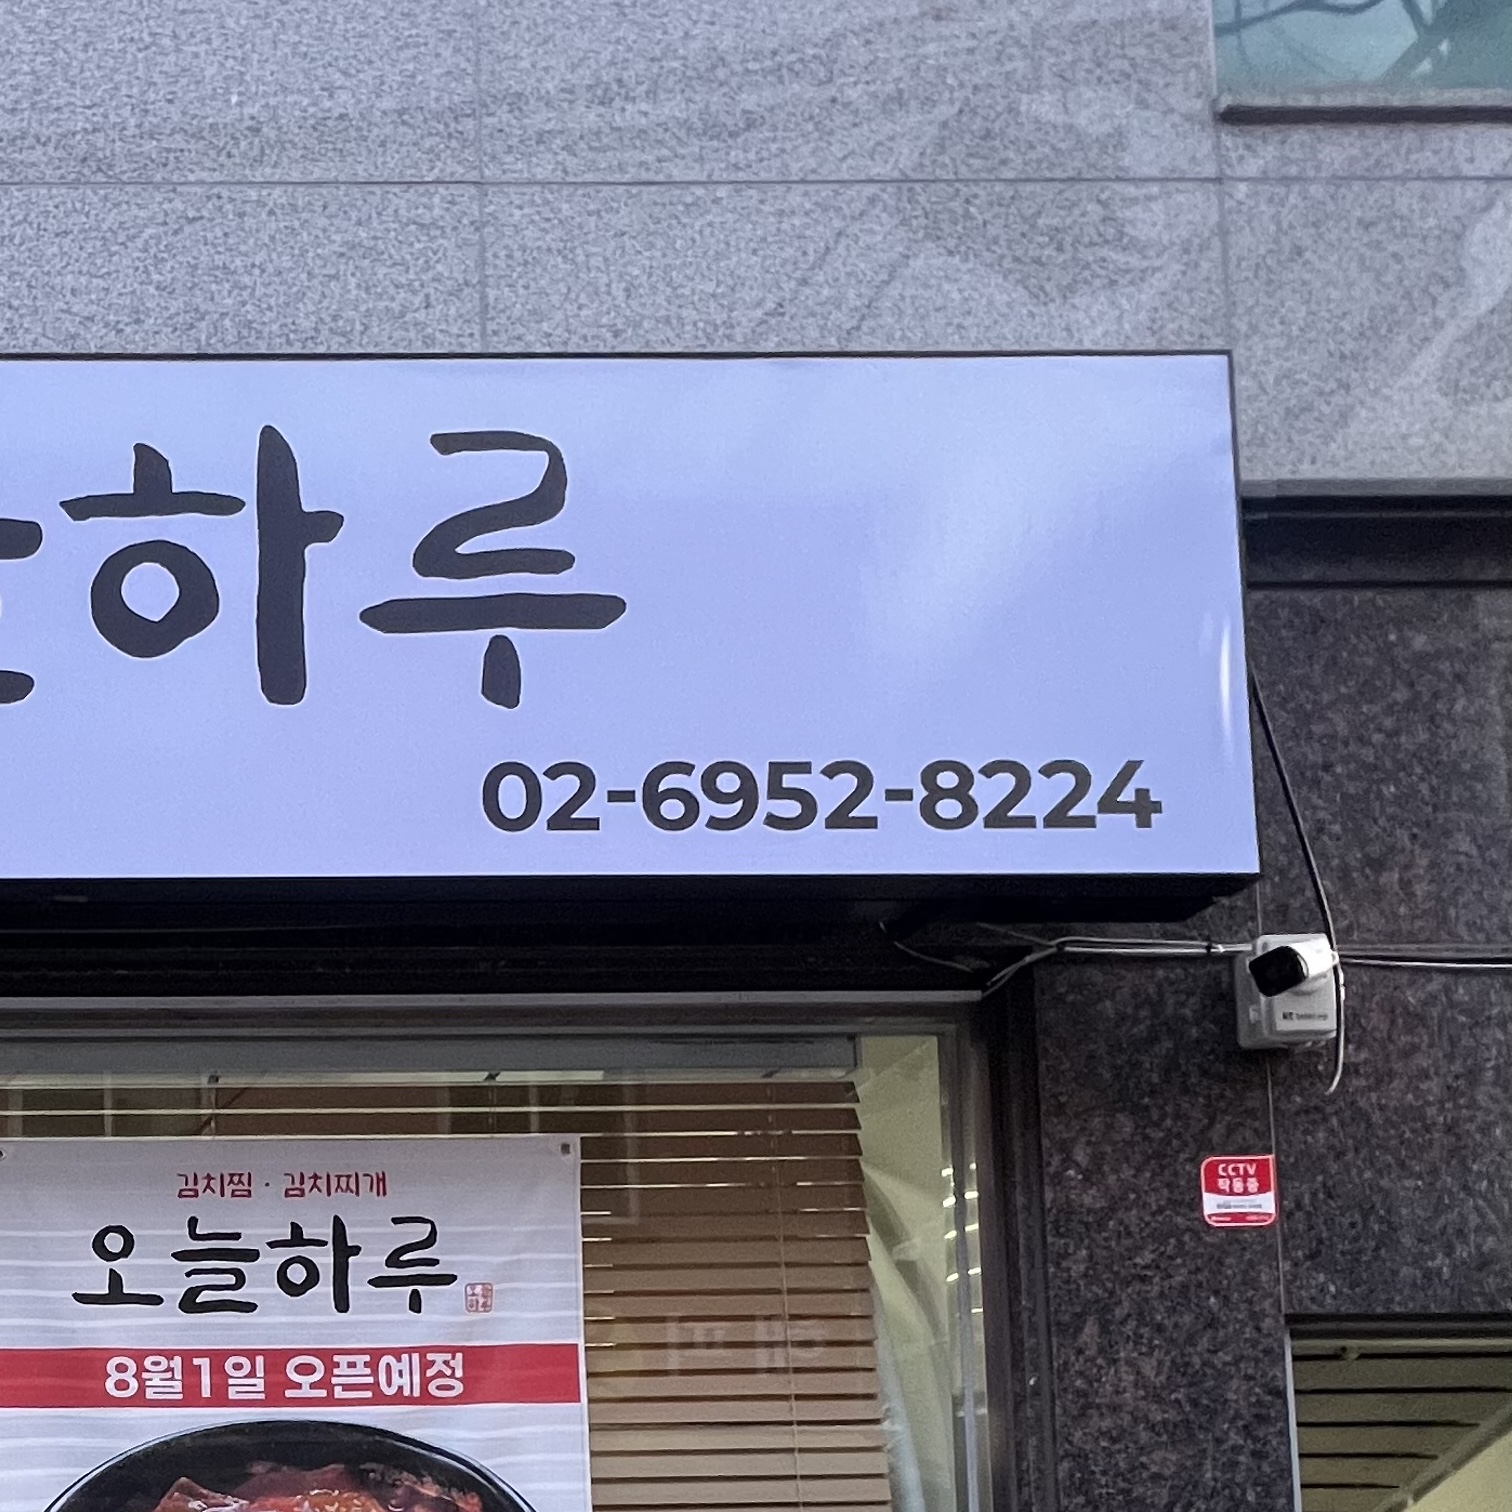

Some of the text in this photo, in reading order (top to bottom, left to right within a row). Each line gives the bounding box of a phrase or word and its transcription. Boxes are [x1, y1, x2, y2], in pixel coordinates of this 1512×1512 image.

[482, 759, 1163, 832] 02-6952-8224
[177, 1171, 253, 1199] 김치찜
[283, 1171, 388, 1198] 김치찌개
[1218, 1163, 1256, 1176] CCTV
[72, 1215, 458, 1314] 오늘하루
[285, 1353, 464, 1398] 오픈예정
